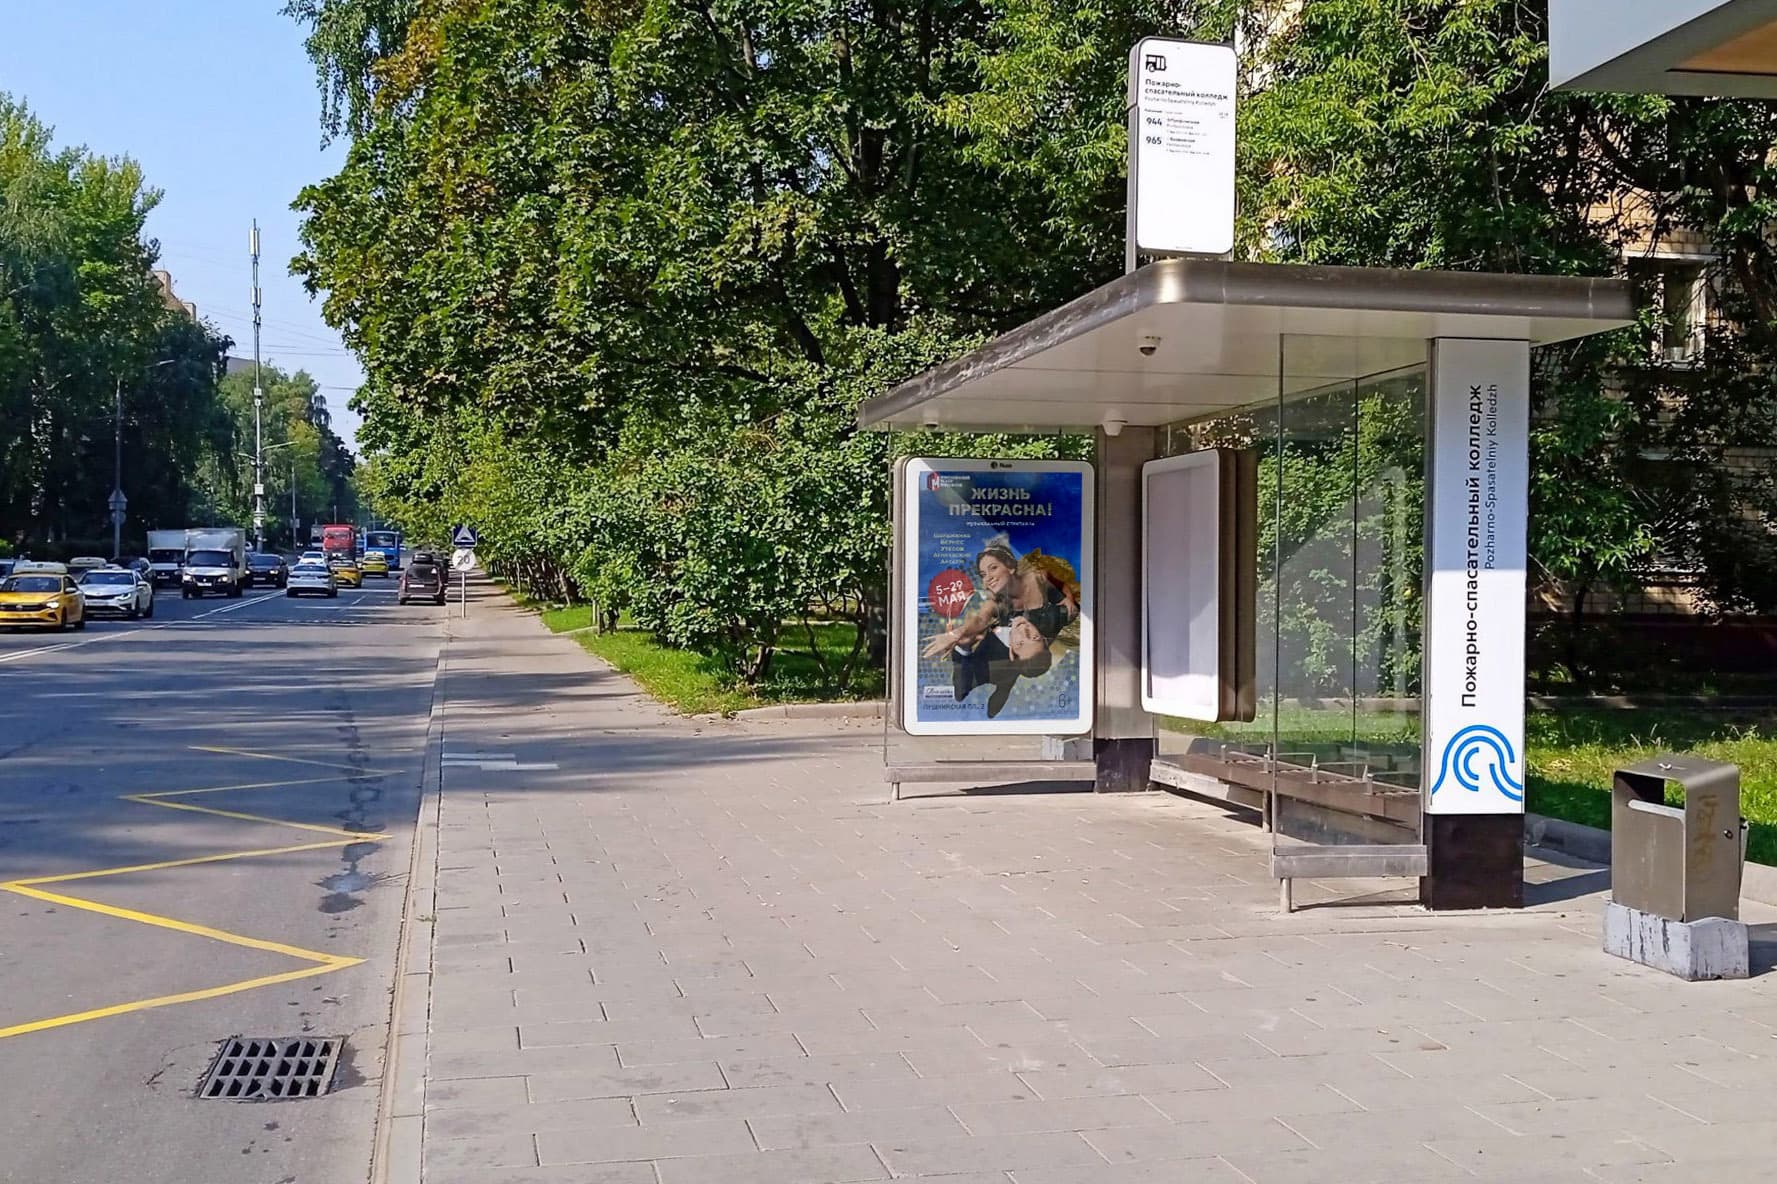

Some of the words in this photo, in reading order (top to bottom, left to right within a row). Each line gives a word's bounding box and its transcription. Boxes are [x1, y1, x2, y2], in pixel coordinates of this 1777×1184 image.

[1145, 78, 1181, 88] Пожарно-
[1145, 87, 1195, 97] спасательный
[1196, 92, 1228, 101] колледж
[1146, 117, 1162, 126] 944
[1145, 136, 1162, 145] 965
[1487, 384, 1498, 437] Kolledzh
[1468, 385, 1483, 471] колледж
[971, 488, 1031, 500] ЖИЗНЬ
[949, 502, 1052, 516] ПРЕКРАСНА!
[1485, 441, 1498, 570] Pozharno-Spasatelniy
[457, 554, 470, 564] 20
[938, 591, 966, 607] МАЯ
[1461, 477, 1481, 707] Пожарно-спасательный
[1058, 693, 1073, 708] 6+
